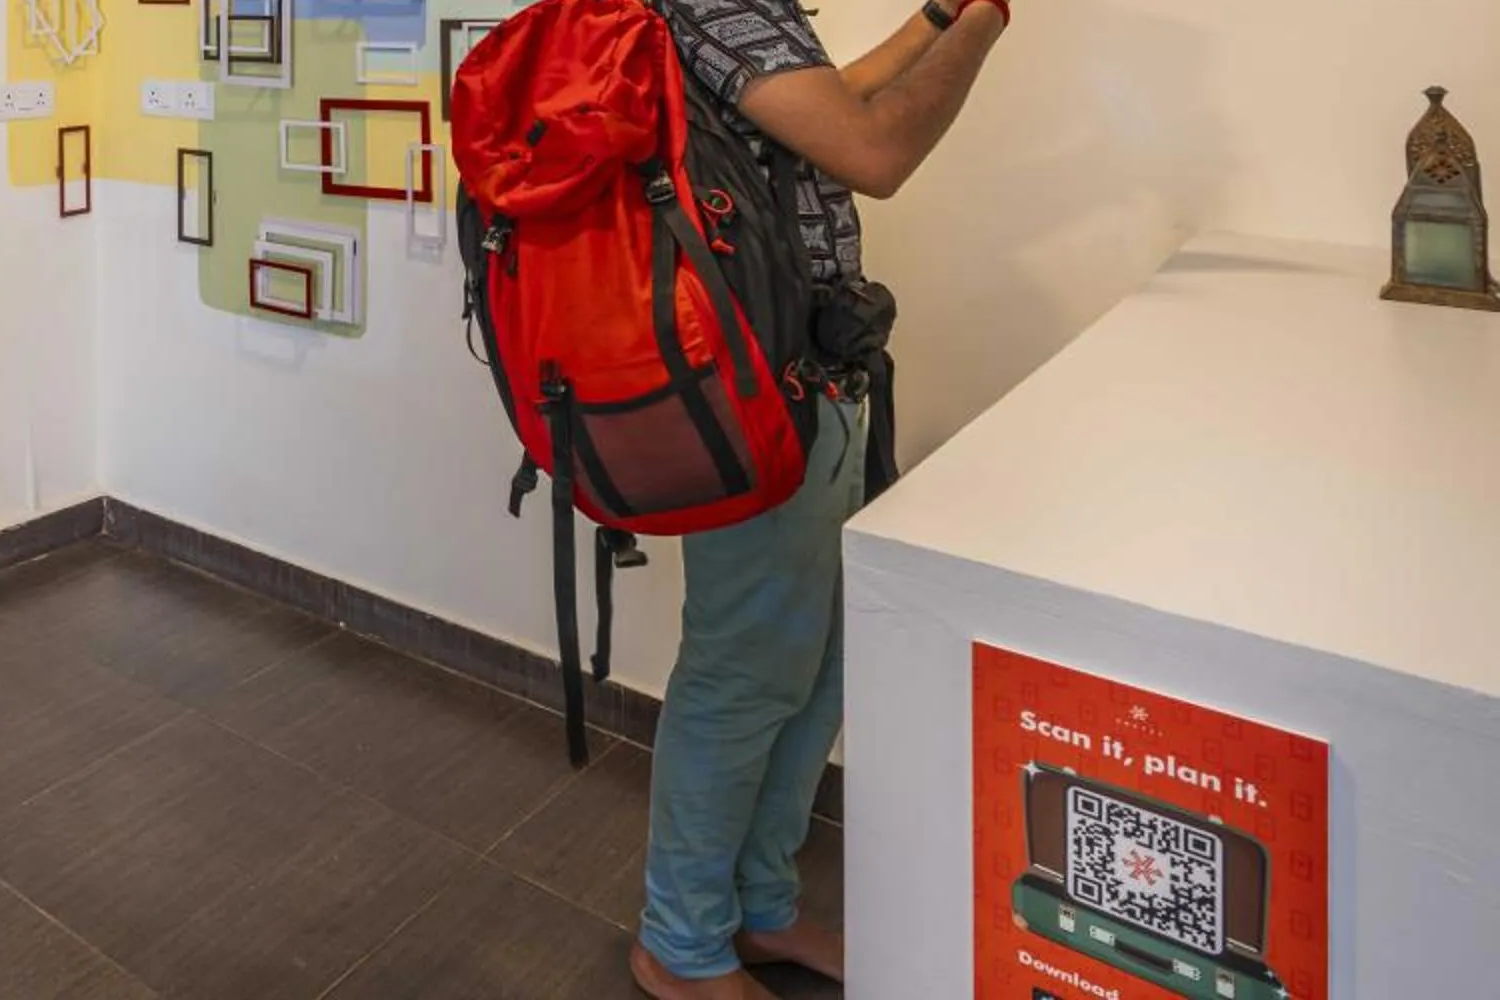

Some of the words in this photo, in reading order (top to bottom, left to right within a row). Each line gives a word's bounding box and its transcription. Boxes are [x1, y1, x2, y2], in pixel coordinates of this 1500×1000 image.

[1019, 709, 1092, 750] Scan
[1102, 734, 1134, 767] it,
[1144, 754, 1222, 793] plan
[1233, 776, 1268, 808] it.
[1017, 948, 1119, 1000] Download
